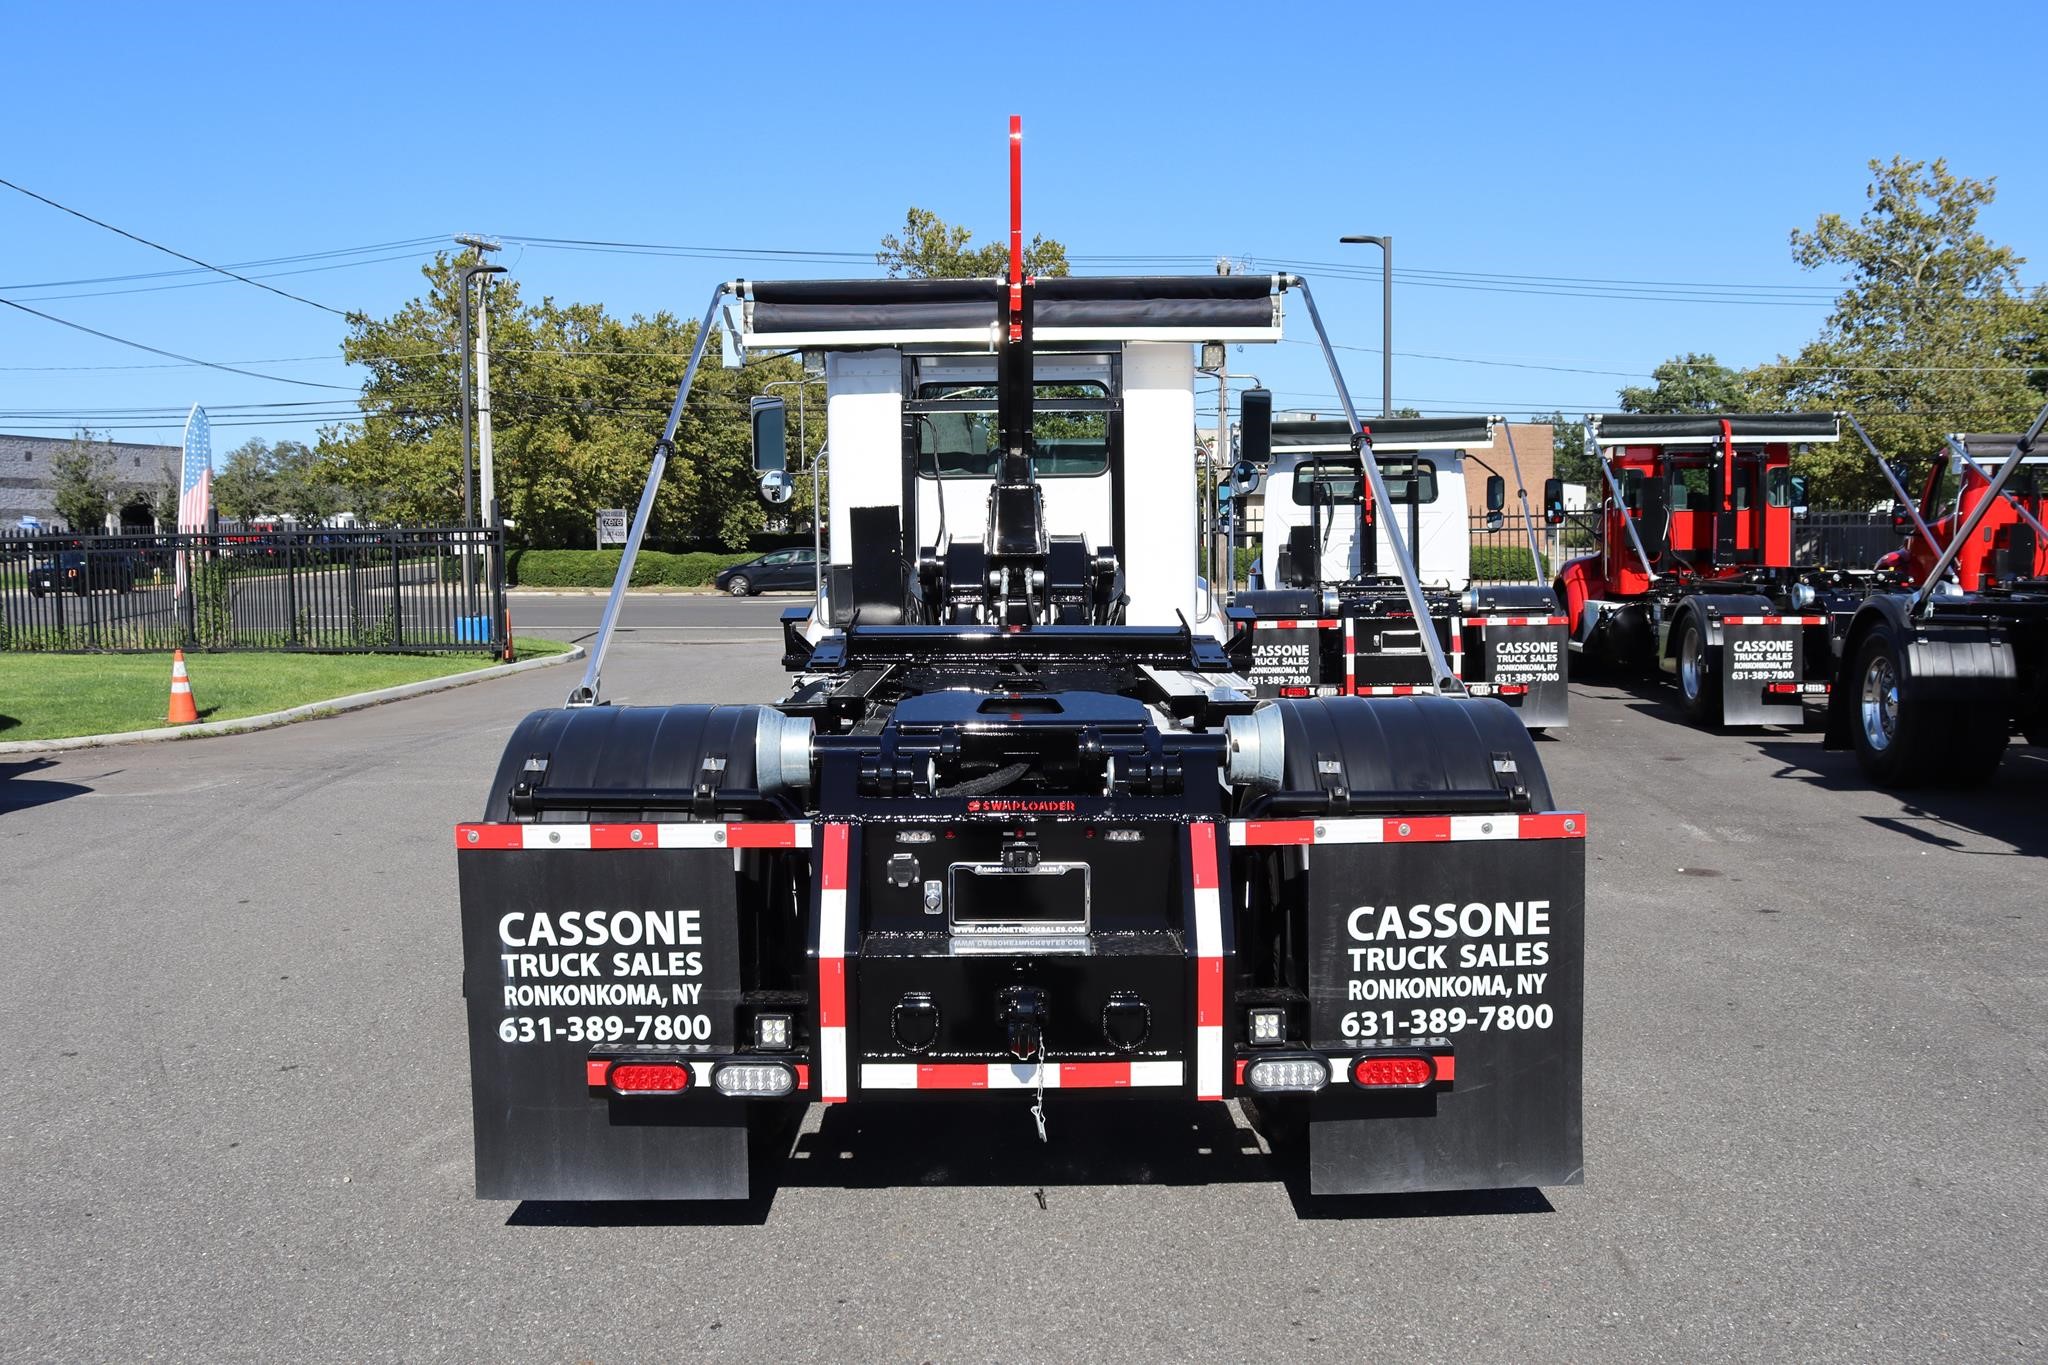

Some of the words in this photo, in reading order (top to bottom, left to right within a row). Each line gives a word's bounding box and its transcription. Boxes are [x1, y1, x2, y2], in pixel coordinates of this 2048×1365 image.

[1496, 642, 1558, 653] CASSONE
[1734, 641, 1793, 652] CASSONE
[1282, 657, 1309, 665] SALES
[1496, 655, 1527, 663] TRUCK
[1529, 654, 1558, 663] SALES
[1733, 653, 1764, 661] TRUCK
[1766, 653, 1793, 661] SALES
[1299, 666, 1309, 674] NY
[1547, 663, 1557, 671] NY
[1248, 676, 1311, 684] 631-389-7800
[1495, 673, 1559, 682] 631-389-7800
[1731, 671, 1795, 680] 631-389-7800
[983, 800, 1076, 811] SWAPLOADER
[1348, 901, 1549, 941] CASSONE
[499, 910, 702, 946] CASSONE
[954, 926, 1086, 934] WWW.CASSONETRUCKSALES.COM
[1348, 945, 1447, 971] TRUCK
[1460, 942, 1549, 968] SALES
[501, 953, 601, 977] TRUCK
[613, 952, 702, 976] SALES
[1349, 975, 1512, 1000] RONKONKOMA,
[1518, 973, 1547, 994] NY
[504, 985, 668, 1009] RONKONKOMA,
[673, 984, 702, 1004] NY
[1341, 1004, 1553, 1037] 631-389-7800
[499, 1015, 711, 1042] 631-389-7800
